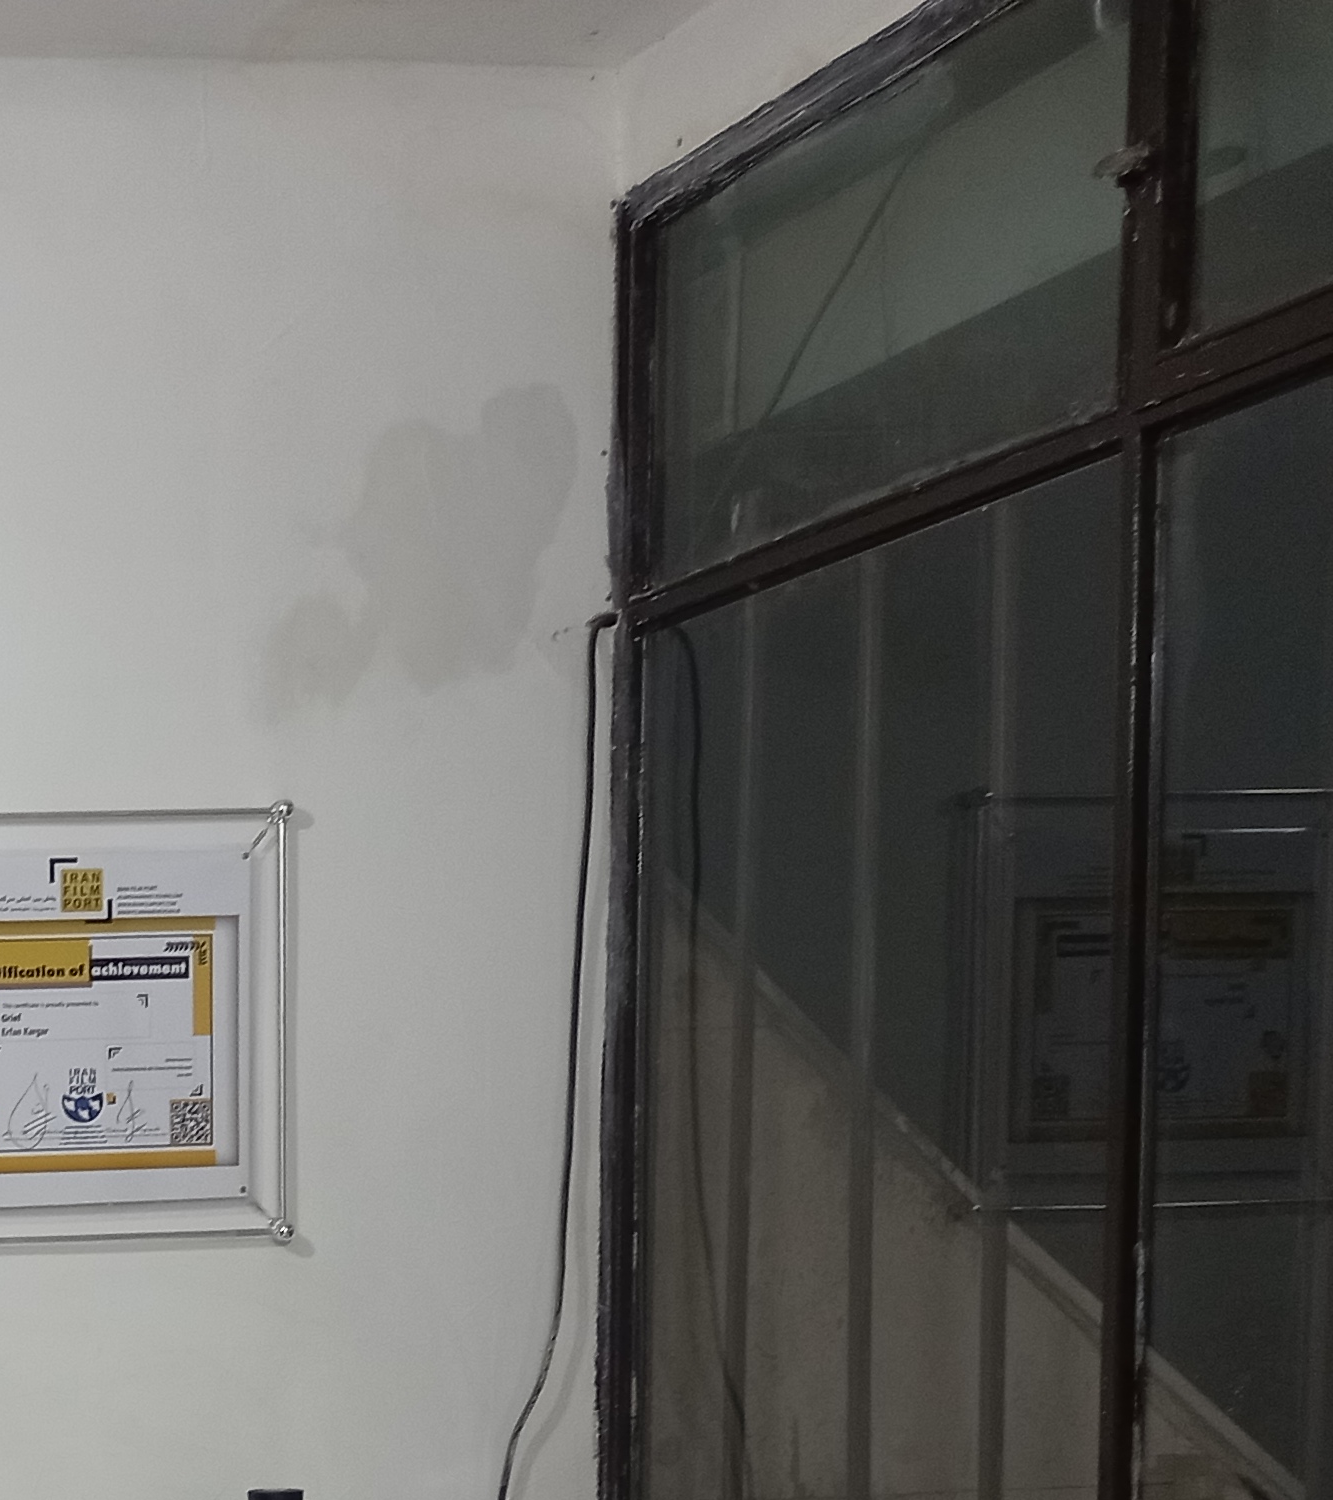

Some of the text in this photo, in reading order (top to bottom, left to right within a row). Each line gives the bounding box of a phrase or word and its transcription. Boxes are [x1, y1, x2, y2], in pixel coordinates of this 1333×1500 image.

[62, 871, 102, 885] IRAN
[62, 885, 101, 898] FILM
[63, 898, 101, 910] PORT
[69, 963, 86, 977] of
[90, 961, 187, 977] achievement
